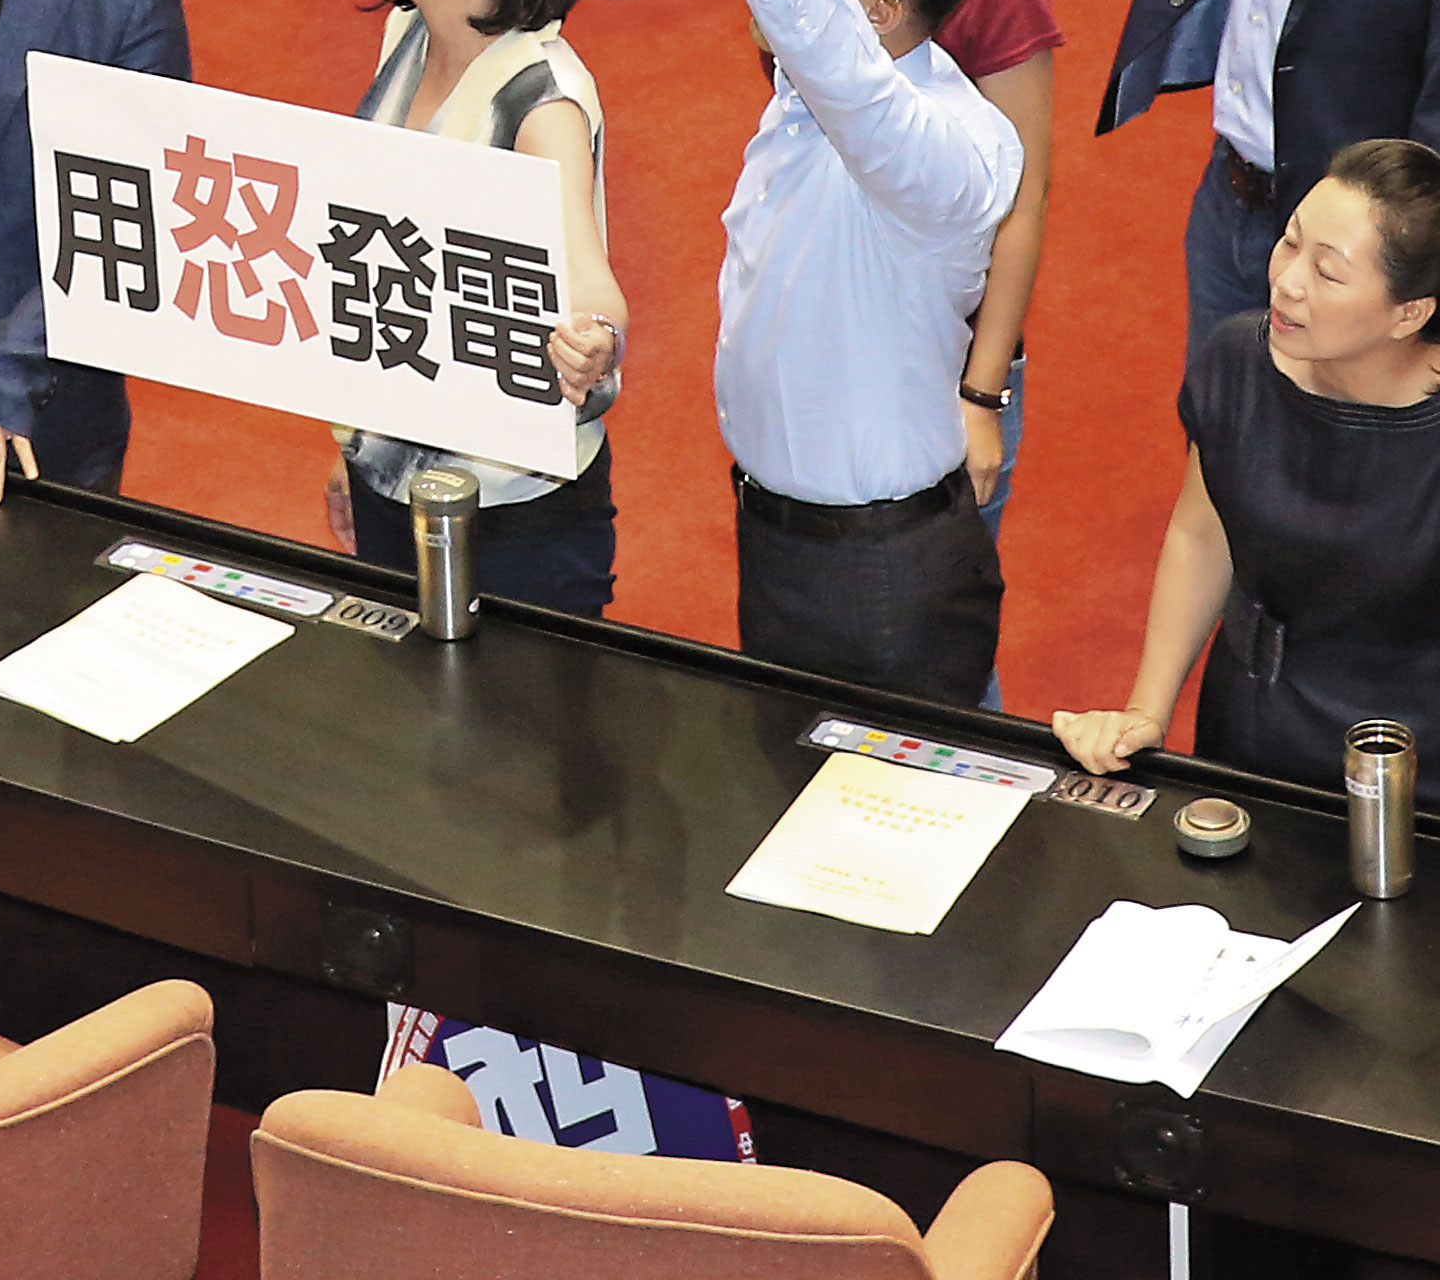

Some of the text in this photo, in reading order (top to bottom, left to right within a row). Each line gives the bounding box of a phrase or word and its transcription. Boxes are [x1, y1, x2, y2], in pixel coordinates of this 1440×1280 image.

[52, 134, 564, 407] 用怒發電
[340, 602, 410, 631] 009
[1068, 778, 1142, 809] 010
